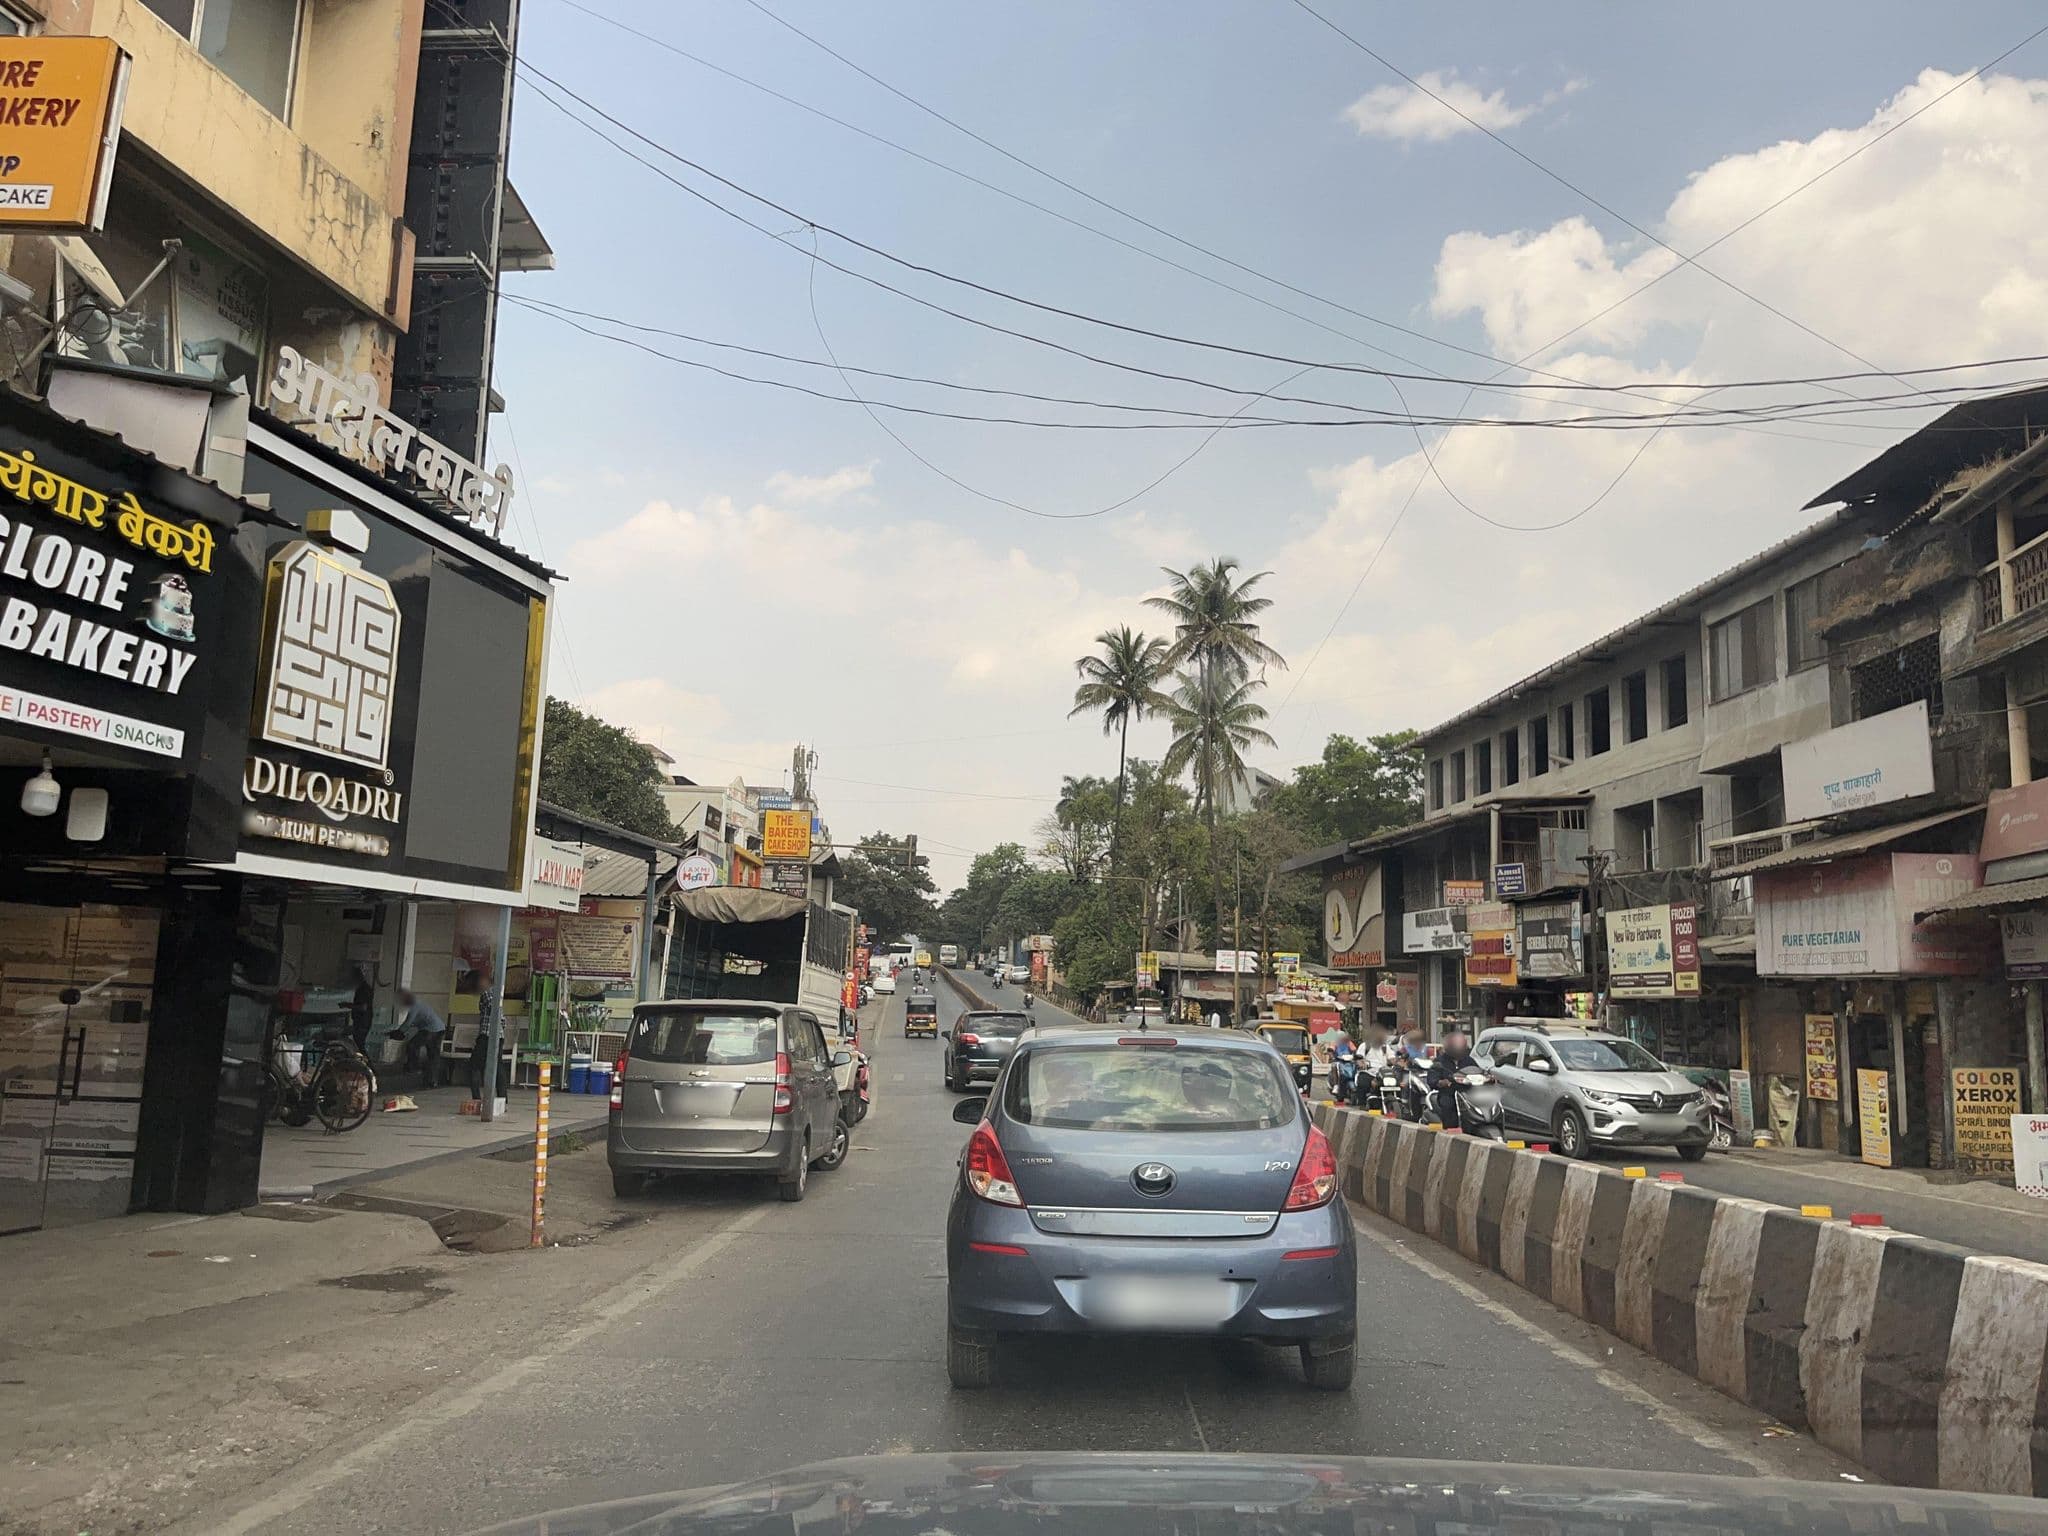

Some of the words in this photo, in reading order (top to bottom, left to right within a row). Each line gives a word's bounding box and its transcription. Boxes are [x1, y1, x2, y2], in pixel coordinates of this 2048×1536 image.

[0, 60, 43, 88] RE
[0, 155, 20, 176] P
[416, 433, 515, 530] कादरी
[118, 492, 215, 573] बेकरी
[1, 598, 197, 694] BAKERY
[0, 693, 13, 713] E
[27, 702, 102, 732] PASTERY
[114, 724, 174, 750] SNACKS
[776, 815, 794, 826] THE
[767, 839, 786, 850] CAKE
[787, 840, 806, 850] SHOP
[539, 858, 563, 885] LAXMI
[1497, 867, 1520, 876] Amul
[1671, 907, 1695, 920] FROZEN
[1637, 927, 1661, 942] Hardware
[1675, 922, 1692, 935] FOOD
[1782, 933, 1803, 947] PURE
[1806, 930, 1861, 946] VEGETARIAN
[1956, 1072, 2014, 1085] COLOR
[1956, 1089, 2016, 1102] XEROX
[1957, 1105, 2014, 1115] LAMINATION
[1955, 1117, 1986, 1127] SPIRAL
[1987, 1118, 2011, 1127] BINDI
[1959, 1130, 1992, 1140] MOBILE
[1963, 1143, 2013, 1153] RECHARGES
